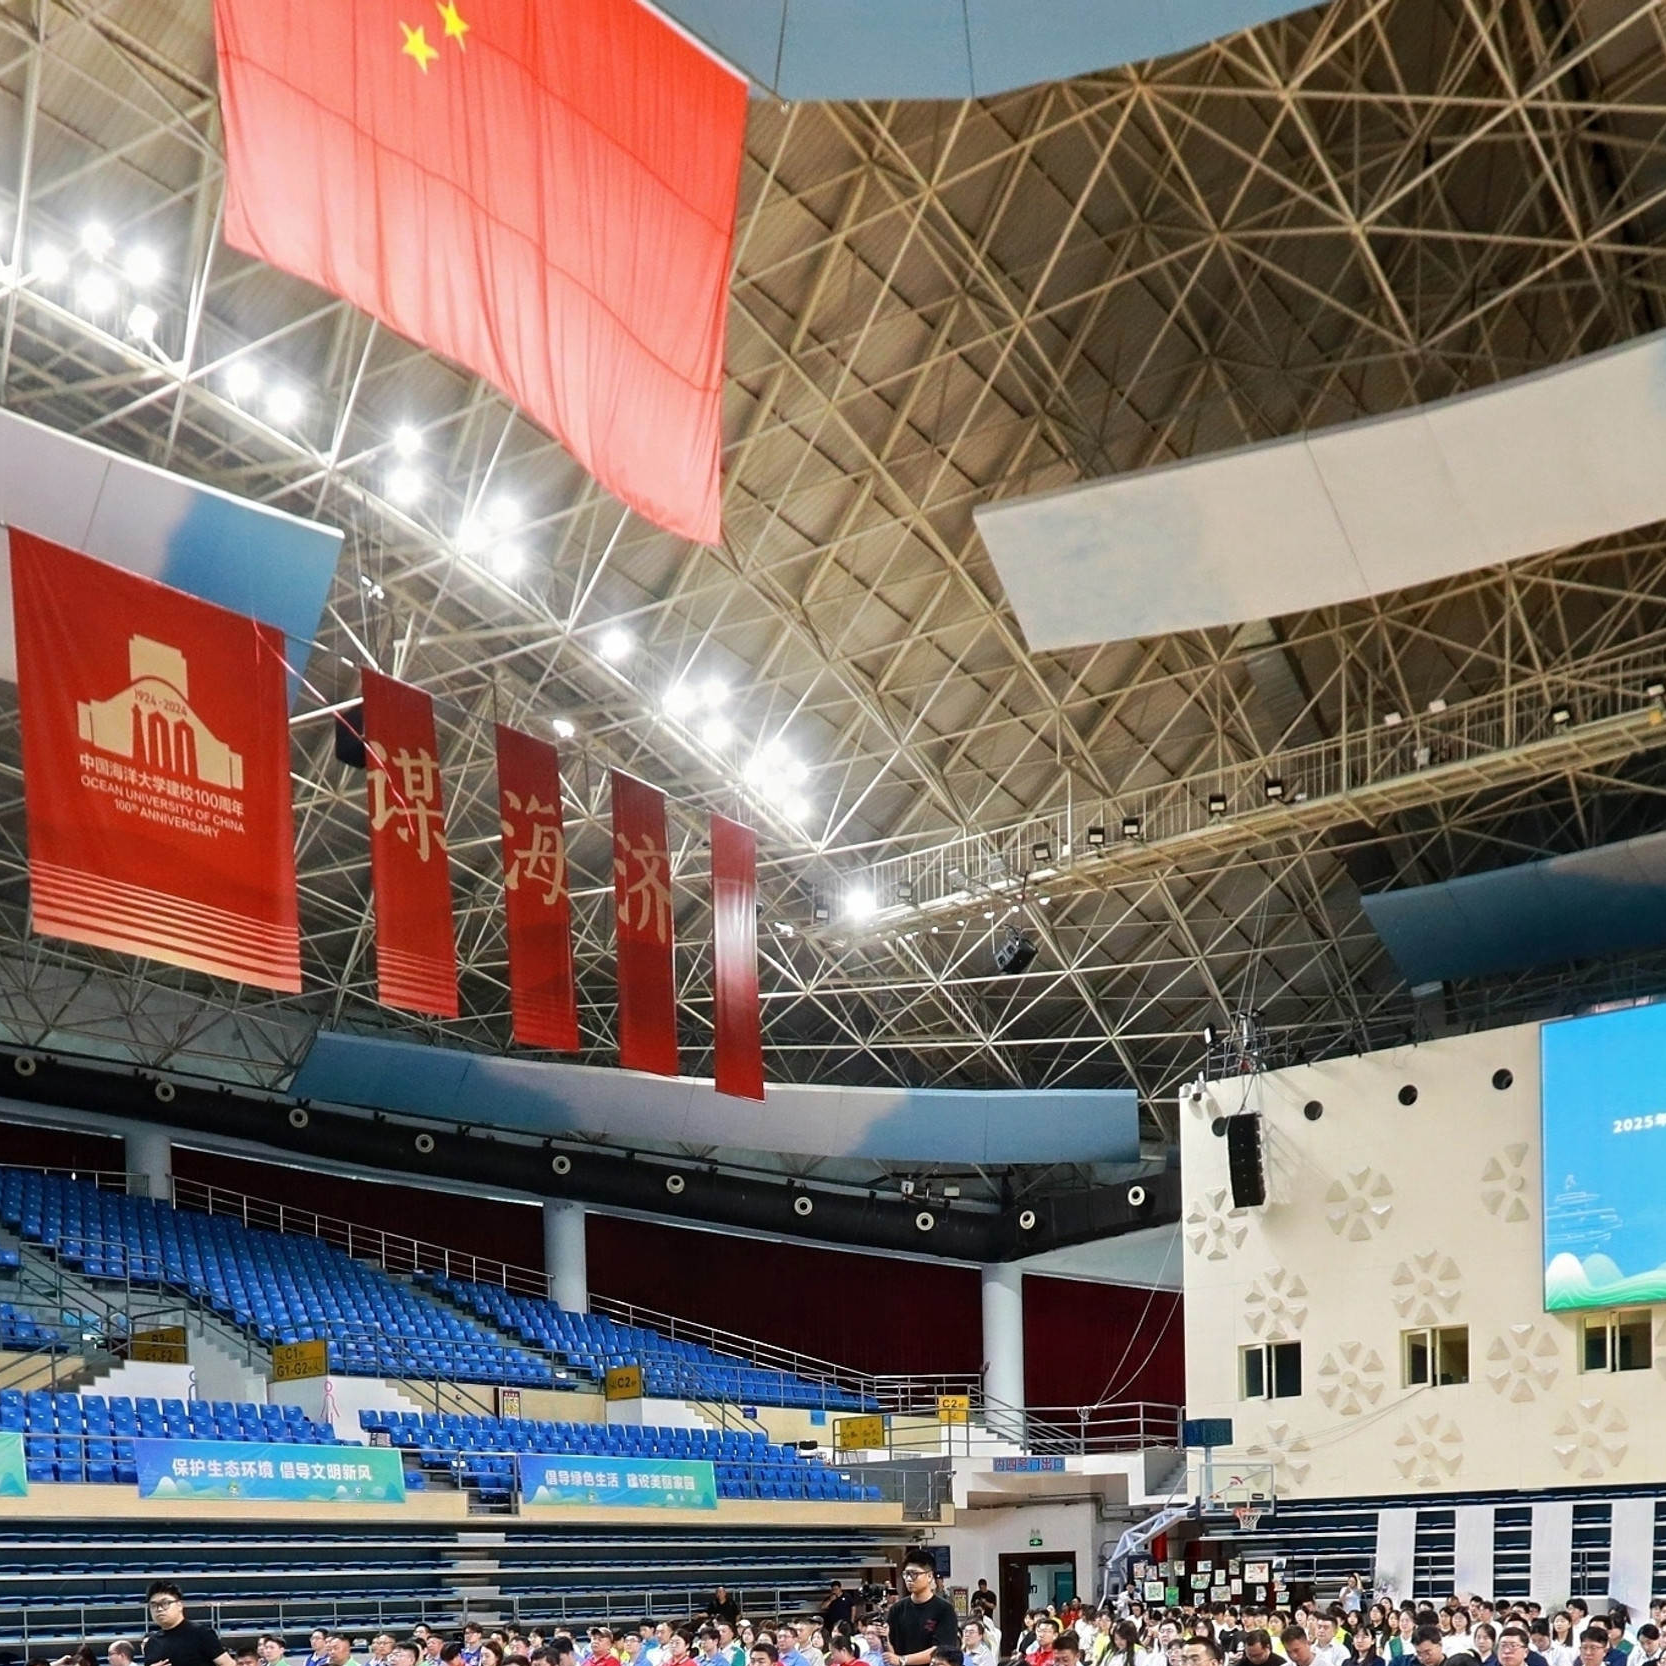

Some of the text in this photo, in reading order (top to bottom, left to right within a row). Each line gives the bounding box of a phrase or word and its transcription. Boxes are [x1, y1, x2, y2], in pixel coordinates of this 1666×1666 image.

[79, 752, 245, 818] 中国海洋大学建校100周年
[81, 774, 245, 834] OCEAN UNIVERSITY OF CHINA
[367, 740, 448, 863] 谋
[140, 806, 220, 839] ANNIVERSARY
[501, 789, 570, 906] 海
[614, 832, 672, 944] 济
[171, 1458, 374, 1482] 保护生态环境 倡导文明新风
[545, 1469, 619, 1488] 倡导绿色生活
